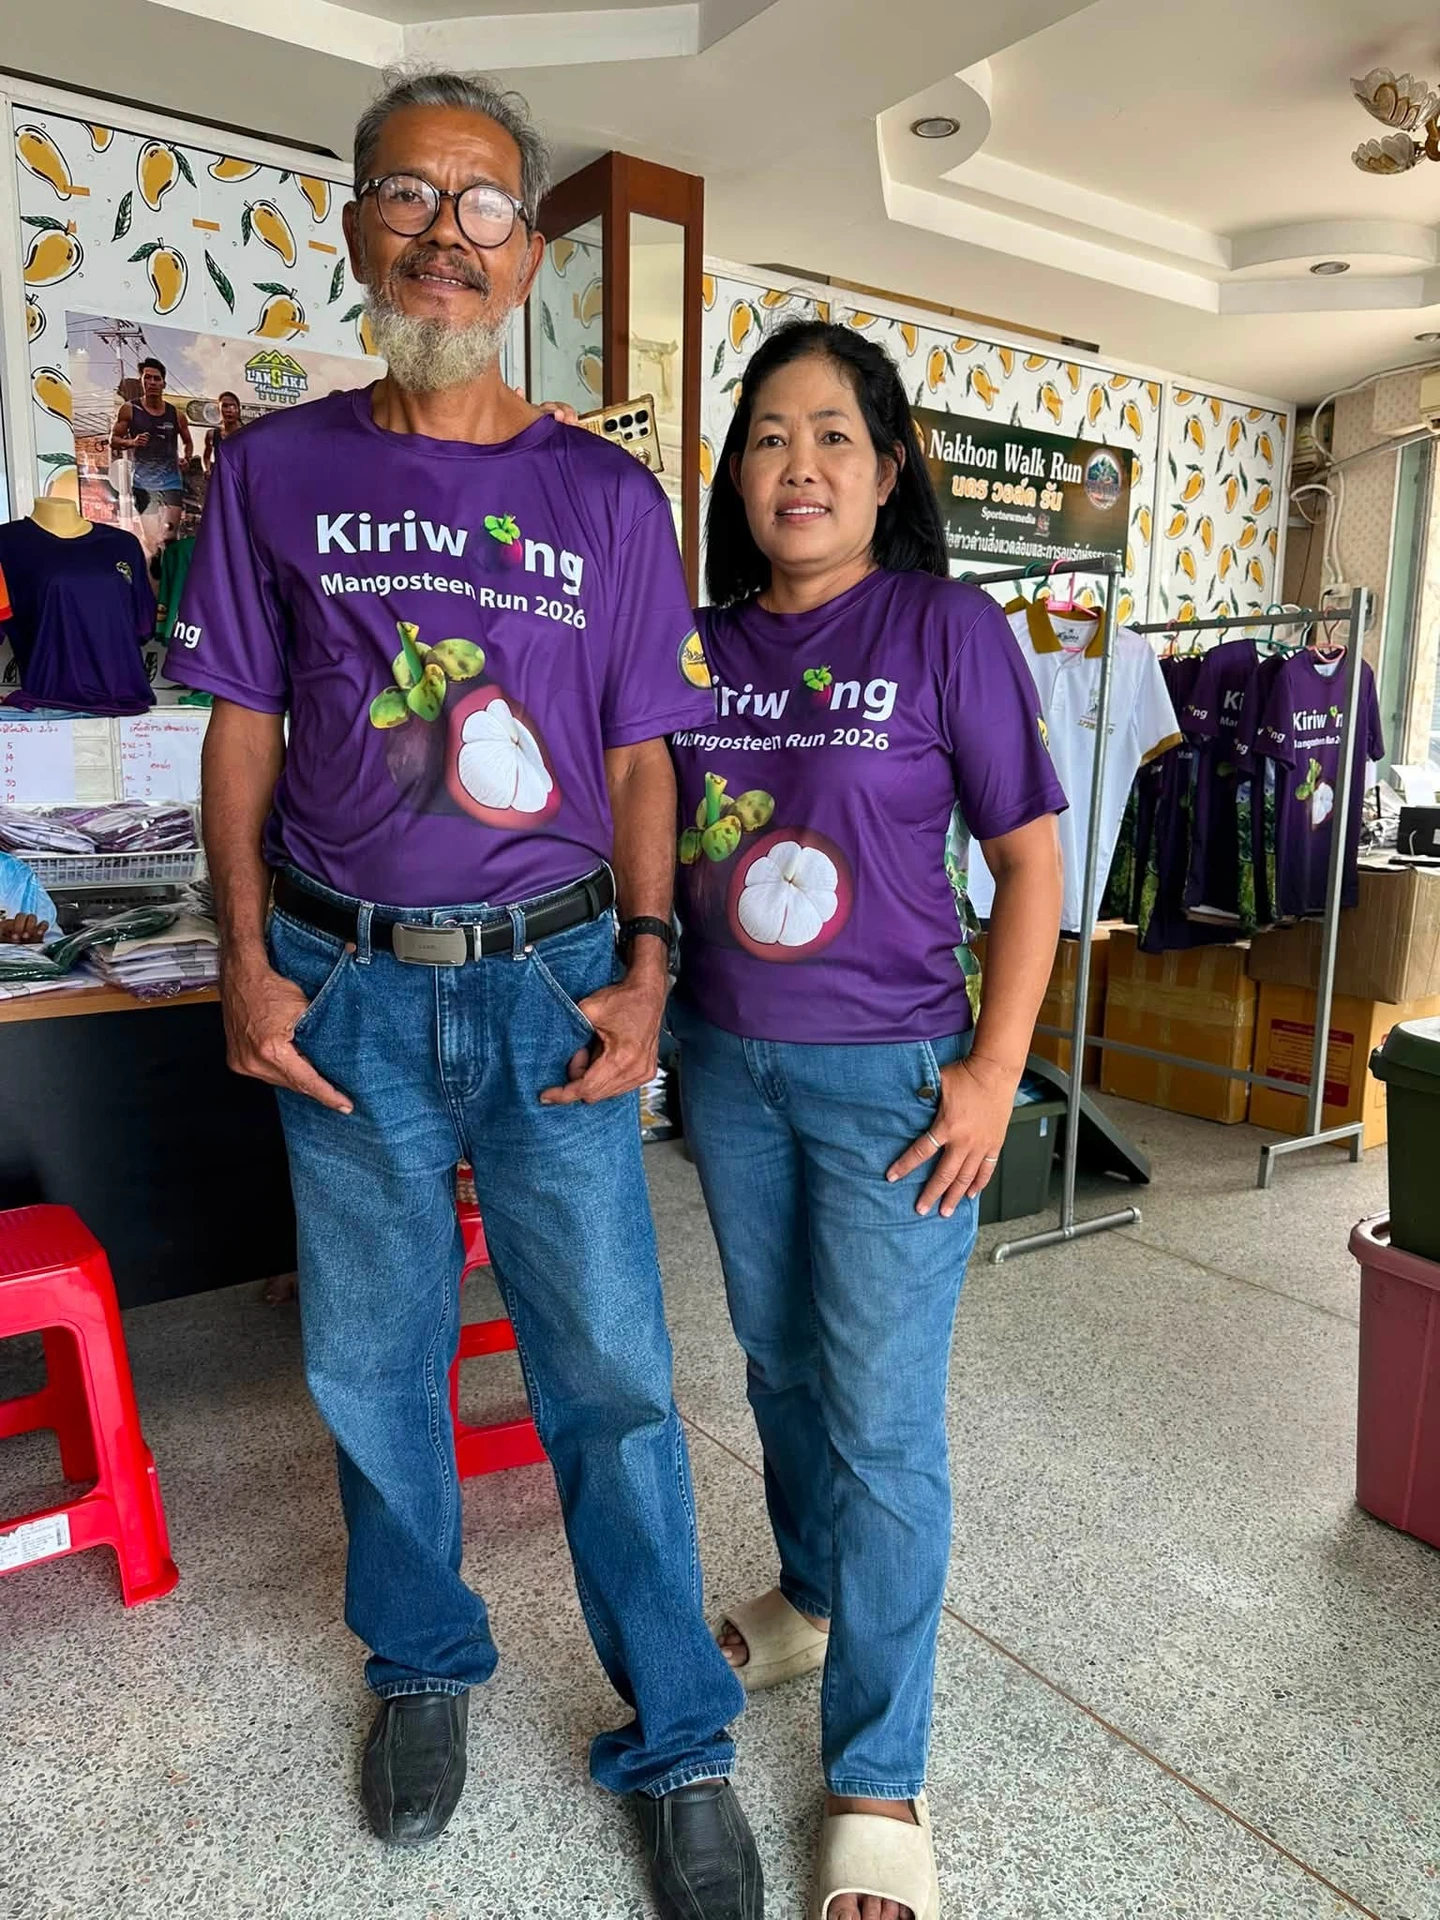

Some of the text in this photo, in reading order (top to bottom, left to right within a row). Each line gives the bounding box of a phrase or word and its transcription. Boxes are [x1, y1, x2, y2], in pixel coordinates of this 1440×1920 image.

[929, 429, 1083, 484] Nakhon Walk Run
[952, 475, 988, 500] นคร
[1040, 481, 1064, 512] รัน
[321, 572, 587, 630] Mangosteen Run 2026
[712, 675, 790, 720] iriw
[786, 733, 826, 748] Run
[830, 728, 889, 751] 2026
